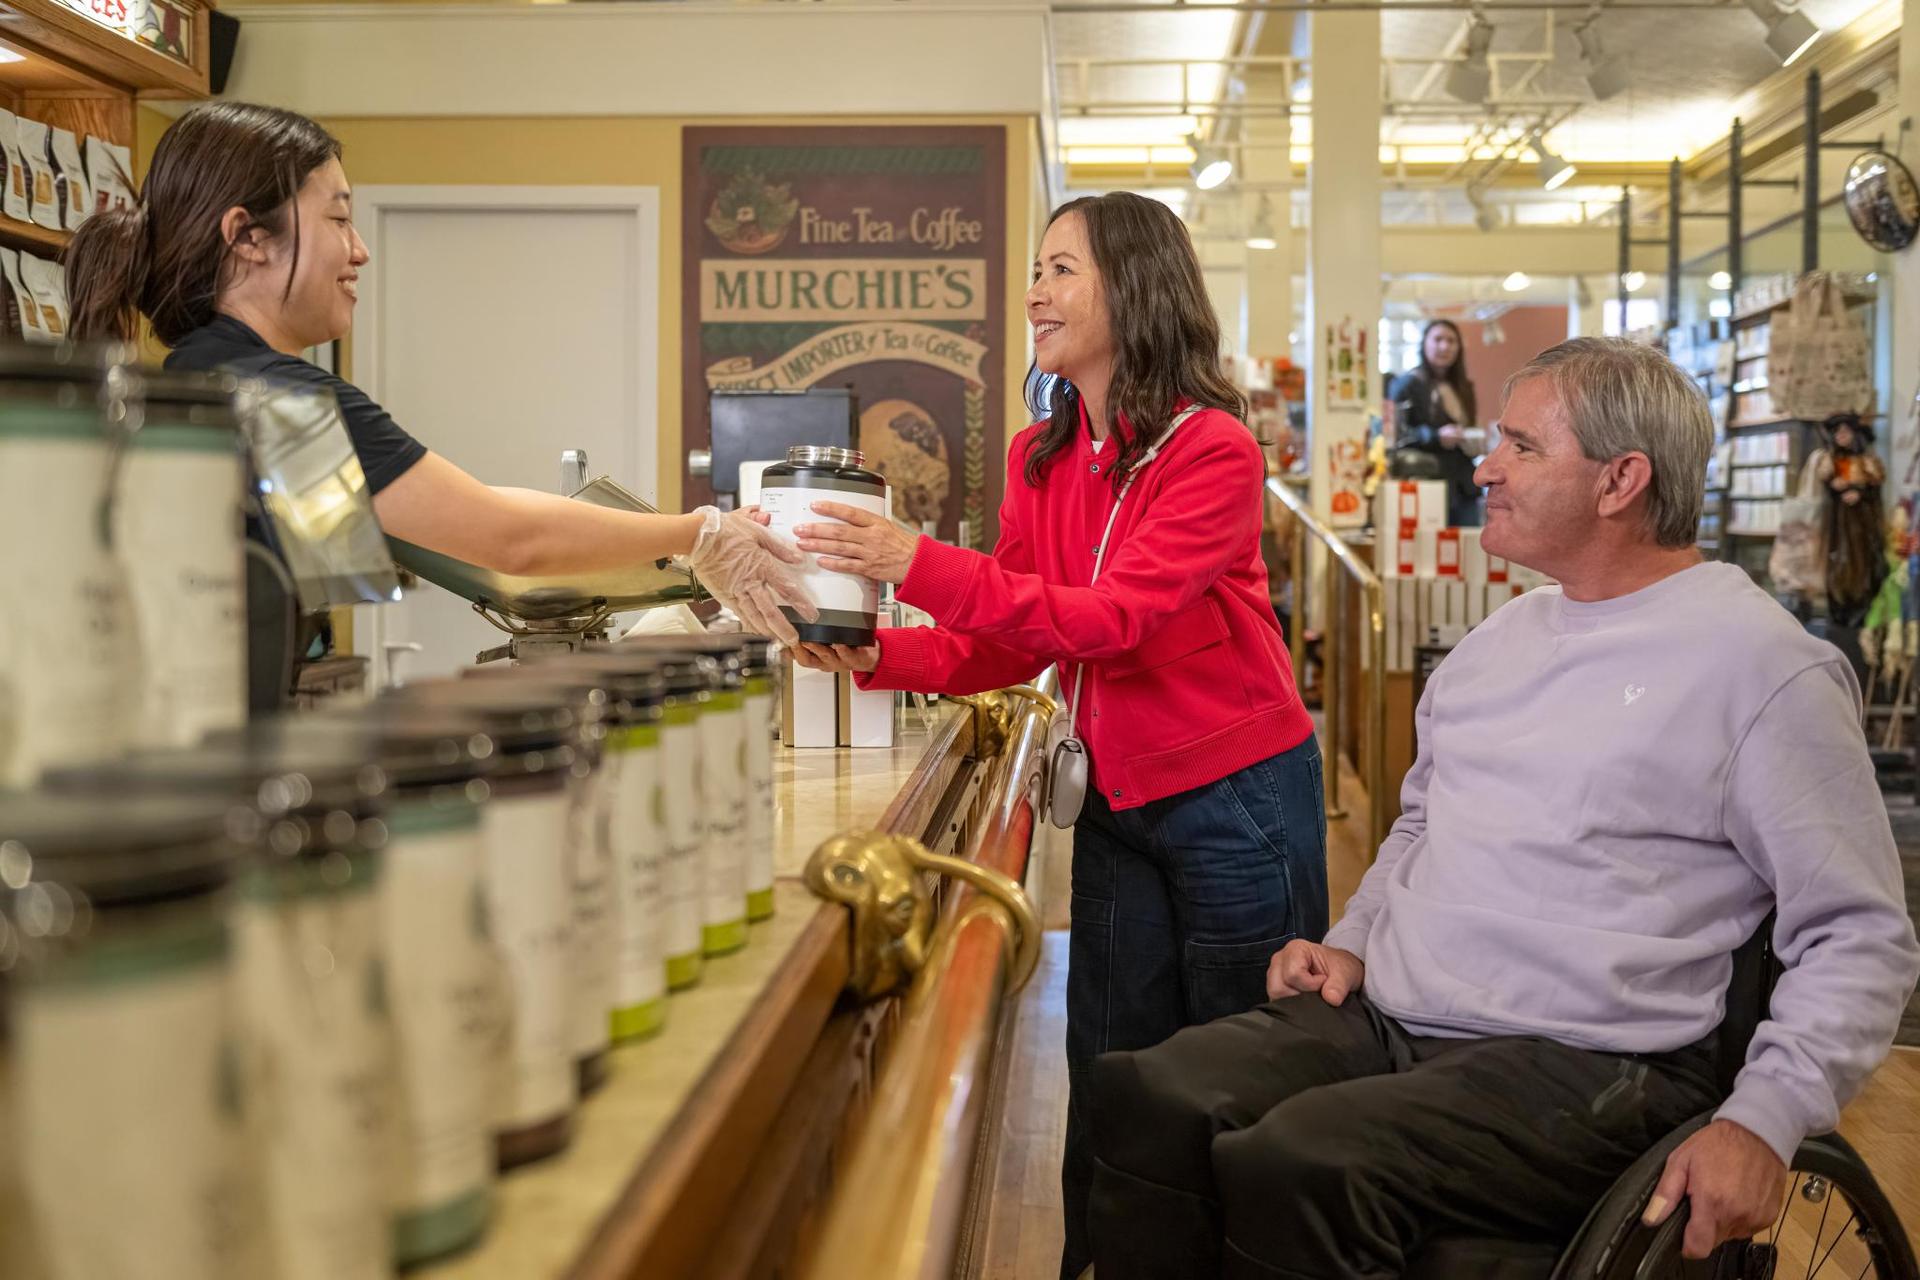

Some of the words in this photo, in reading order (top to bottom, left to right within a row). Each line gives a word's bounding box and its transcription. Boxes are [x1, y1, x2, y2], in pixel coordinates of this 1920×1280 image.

[800, 207, 849, 243] Fine
[852, 207, 894, 243] Tea
[910, 207, 982, 250] Coffee
[714, 265, 974, 310] MURCHIE'S
[780, 330, 867, 385] IMPORTER
[883, 329, 909, 350] Tea
[926, 334, 973, 367] Coffee
